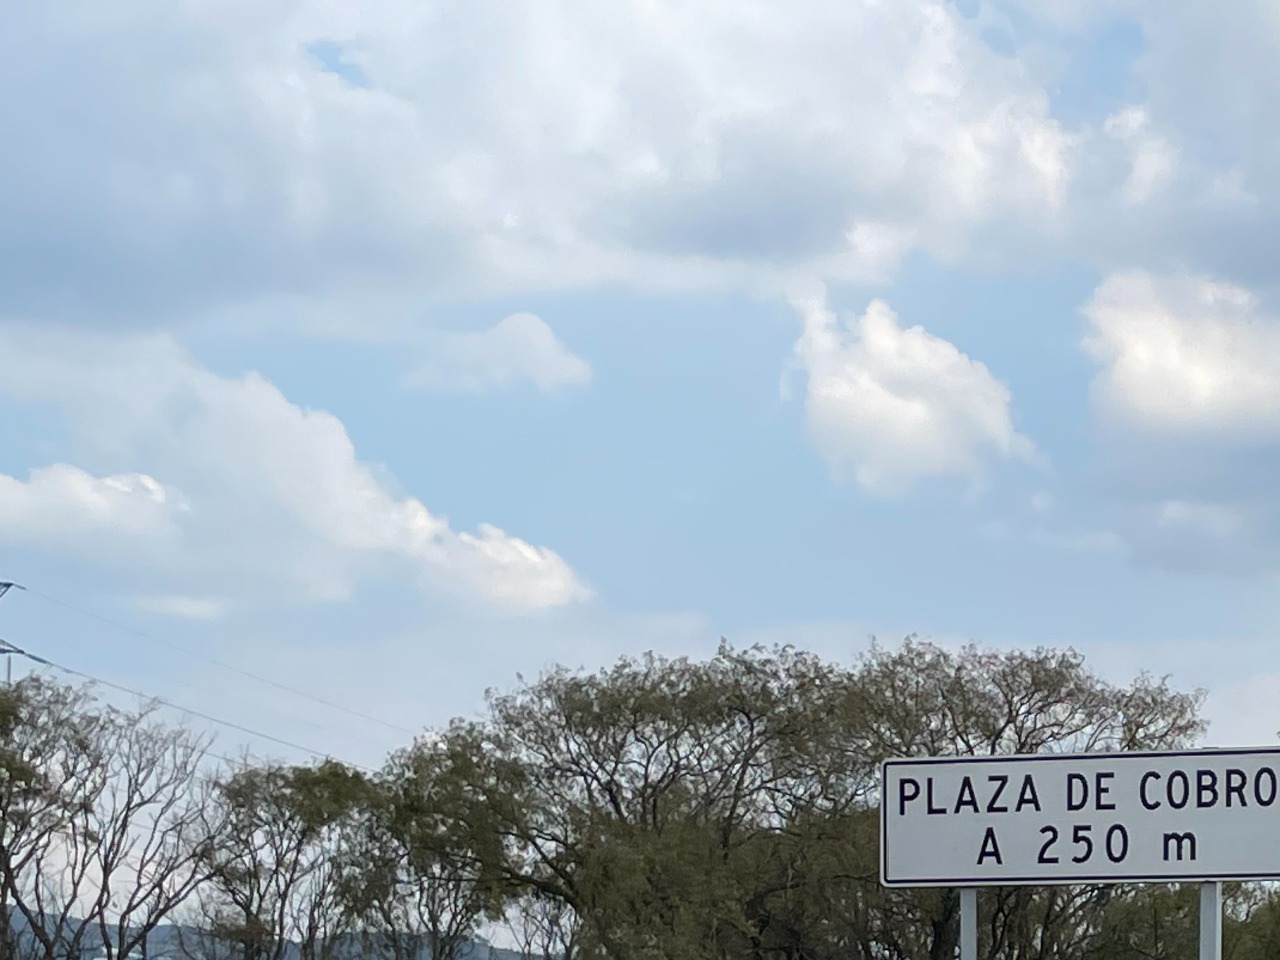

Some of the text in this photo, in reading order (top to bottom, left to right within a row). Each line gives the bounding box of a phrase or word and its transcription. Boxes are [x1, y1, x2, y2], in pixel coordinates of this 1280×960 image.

[899, 766, 1278, 816] PLAZA DE COBRO
[976, 823, 1197, 866] A 250 m
